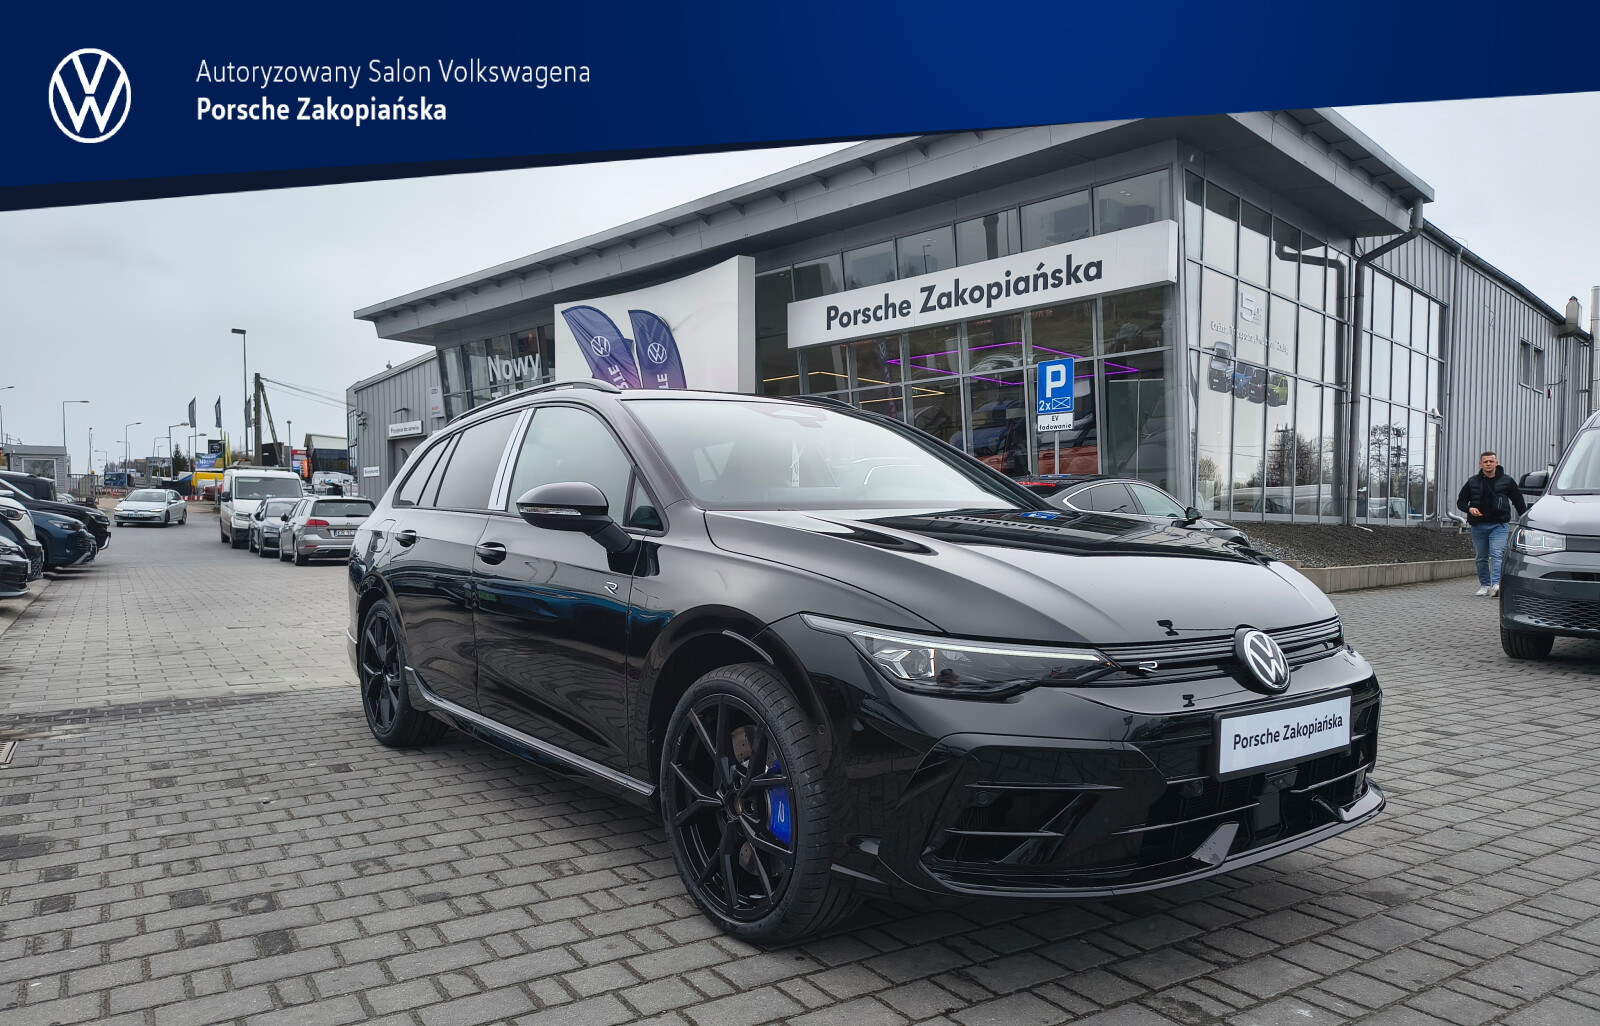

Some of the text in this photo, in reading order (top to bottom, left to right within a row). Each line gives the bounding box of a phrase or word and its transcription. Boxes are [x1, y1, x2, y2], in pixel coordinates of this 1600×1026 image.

[826, 253, 1103, 331] Porsche Zakopiańska
[487, 353, 540, 383] Nowy
[1045, 364, 1067, 398] P
[1038, 399, 1052, 412] 2x
[1038, 422, 1072, 431] ładowanie
[1233, 713, 1343, 751] Porsche Zakopiańska
